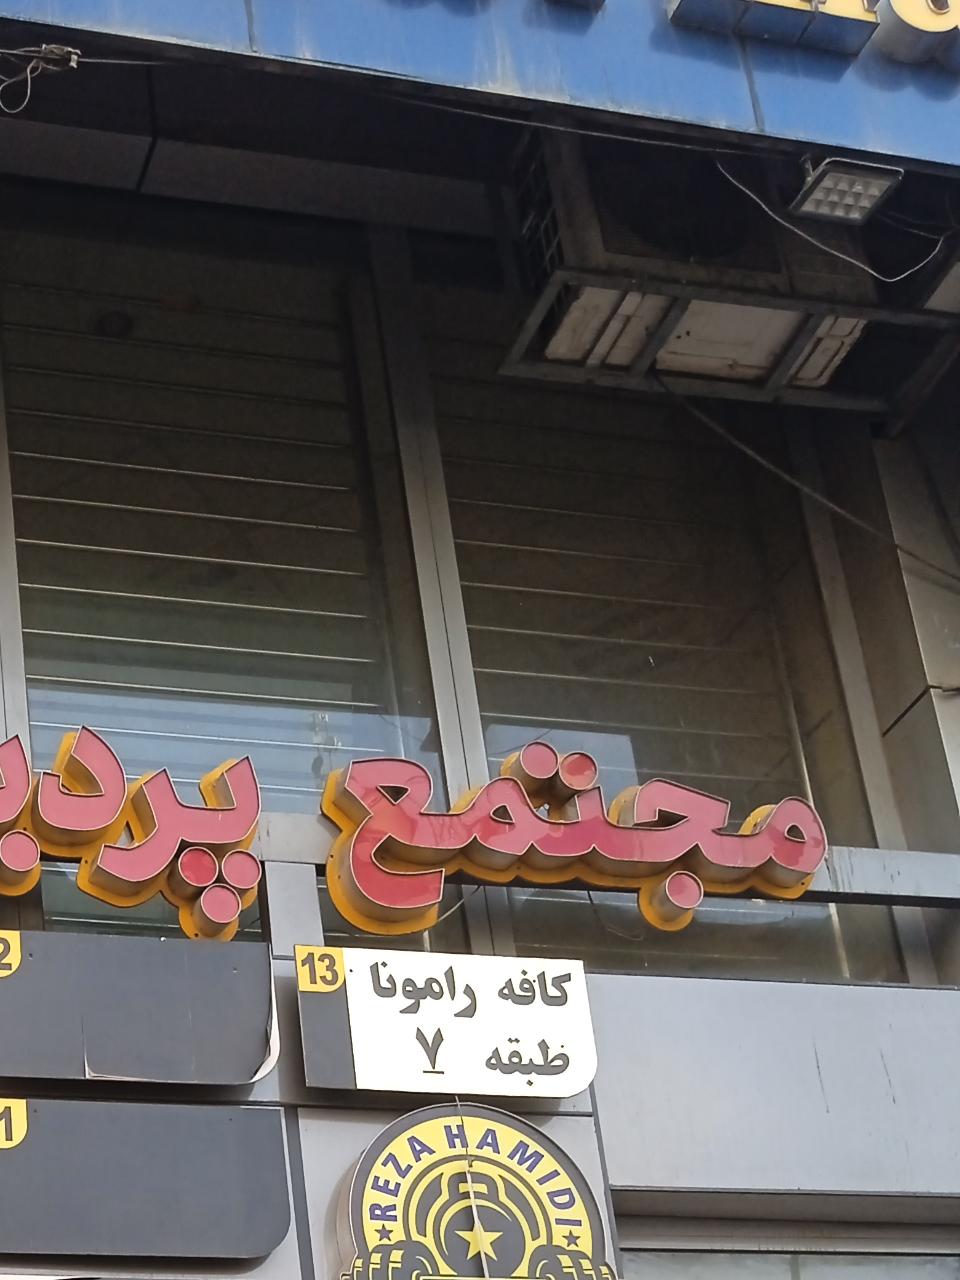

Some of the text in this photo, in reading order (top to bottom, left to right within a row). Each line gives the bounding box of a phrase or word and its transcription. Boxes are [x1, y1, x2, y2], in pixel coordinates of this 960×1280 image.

[325, 741, 828, 934] مجتمع
[300, 952, 340, 986] 13
[369, 961, 572, 1018] کافه رامونا
[415, 1027, 571, 1087] طبقه ۷
[369, 1124, 583, 1228] REZA HAMIDI
